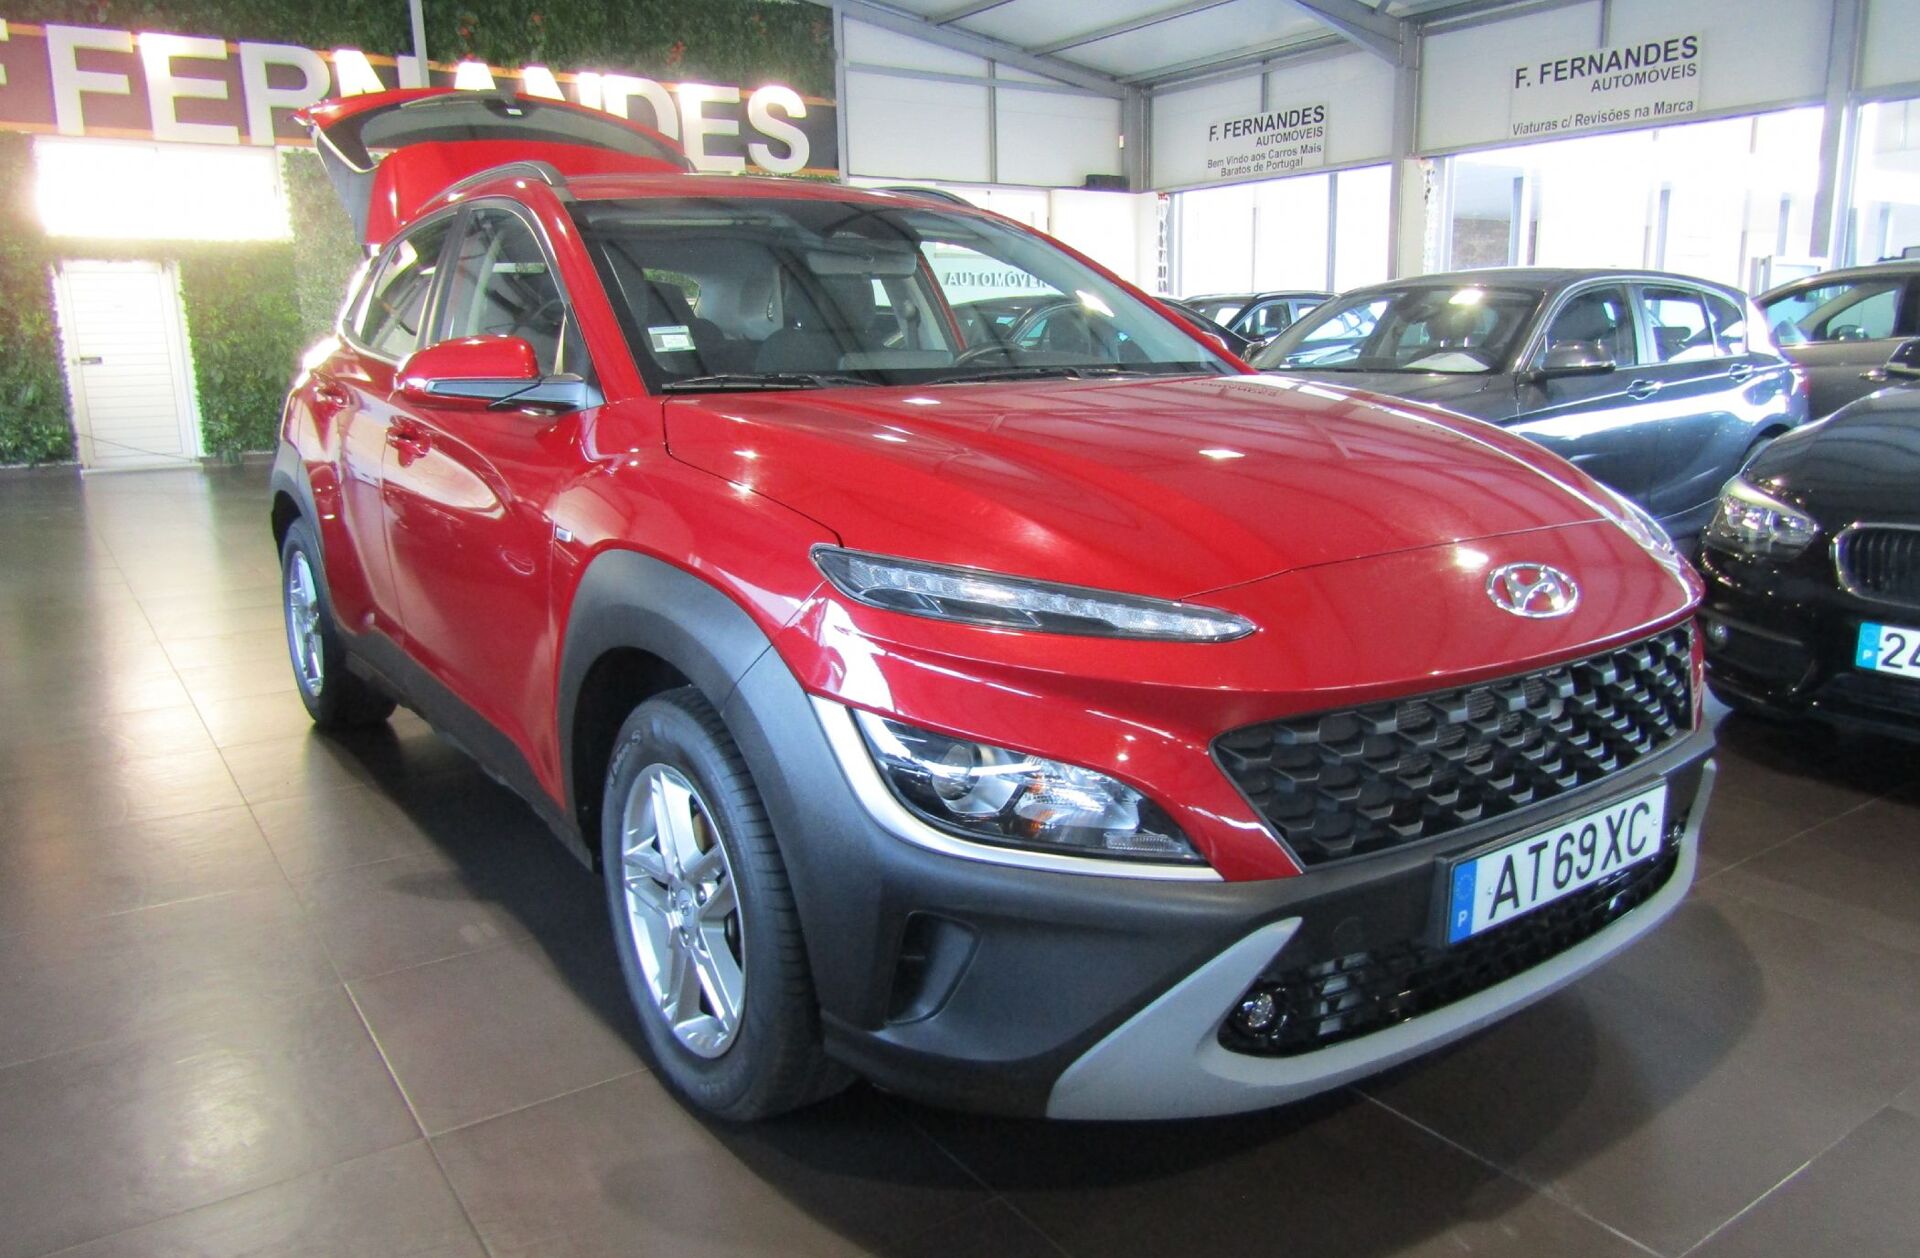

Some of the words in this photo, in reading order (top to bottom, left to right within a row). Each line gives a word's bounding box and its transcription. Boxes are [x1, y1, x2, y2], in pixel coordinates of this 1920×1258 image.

[1514, 66, 1531, 89] F.
[1539, 35, 1699, 85] FERNANDES
[1591, 62, 1697, 93] AUTOMÓVEIS
[46, 23, 811, 174] FERDES
[1209, 125, 1219, 141] F.
[1224, 105, 1324, 139] FERNANDES
[1512, 120, 1558, 136] Viaturas
[1561, 115, 1573, 130] c/
[1574, 108, 1631, 127] Revisões
[1634, 105, 1650, 119] na
[1653, 99, 1694, 115] Marca
[1207, 159, 1223, 168] Bem
[1226, 155, 1248, 165] Vindo
[1250, 151, 1266, 162] aos
[1268, 148, 1297, 158] Carros
[1300, 142, 1322, 155] Mais
[1220, 166, 1252, 177] Baratos
[1253, 162, 1264, 173] de
[1266, 157, 1303, 169] Portugal
[1488, 802, 1650, 920] AT69XC
[1457, 909, 1468, 928] P
